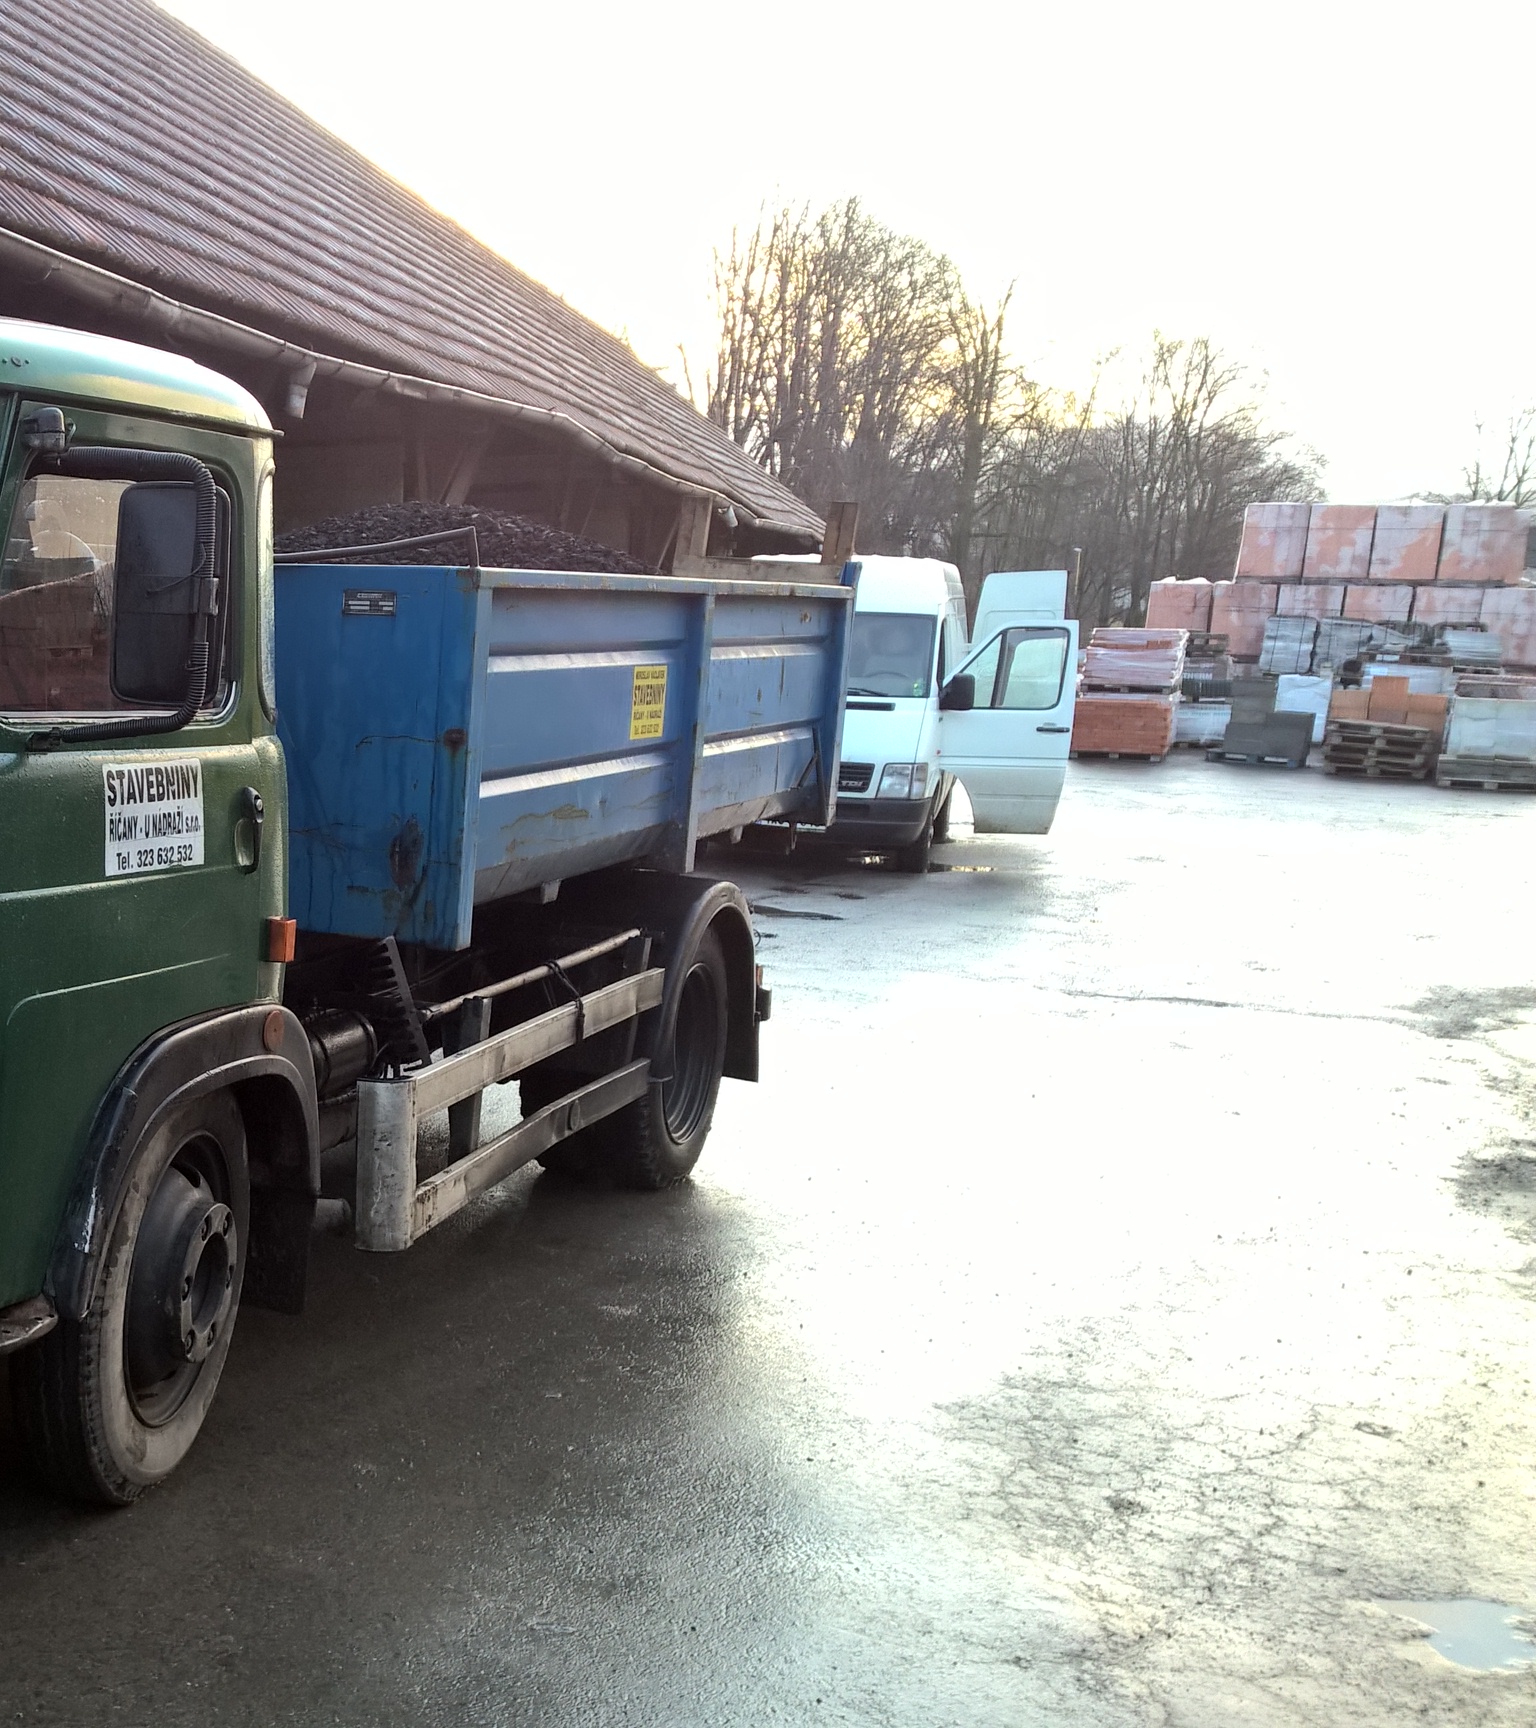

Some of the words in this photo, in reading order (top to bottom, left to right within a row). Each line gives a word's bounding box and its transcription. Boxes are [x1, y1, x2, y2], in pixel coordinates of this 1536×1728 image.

[106, 764, 198, 807] STAVEBNINY
[109, 810, 138, 842] ŘÍČANY
[144, 814, 150, 839] U
[152, 806, 184, 837] NÁDRAŽÍ
[116, 851, 134, 871] Tel.
[137, 848, 154, 868] 323
[157, 846, 175, 865] 632
[177, 843, 193, 862] 532
